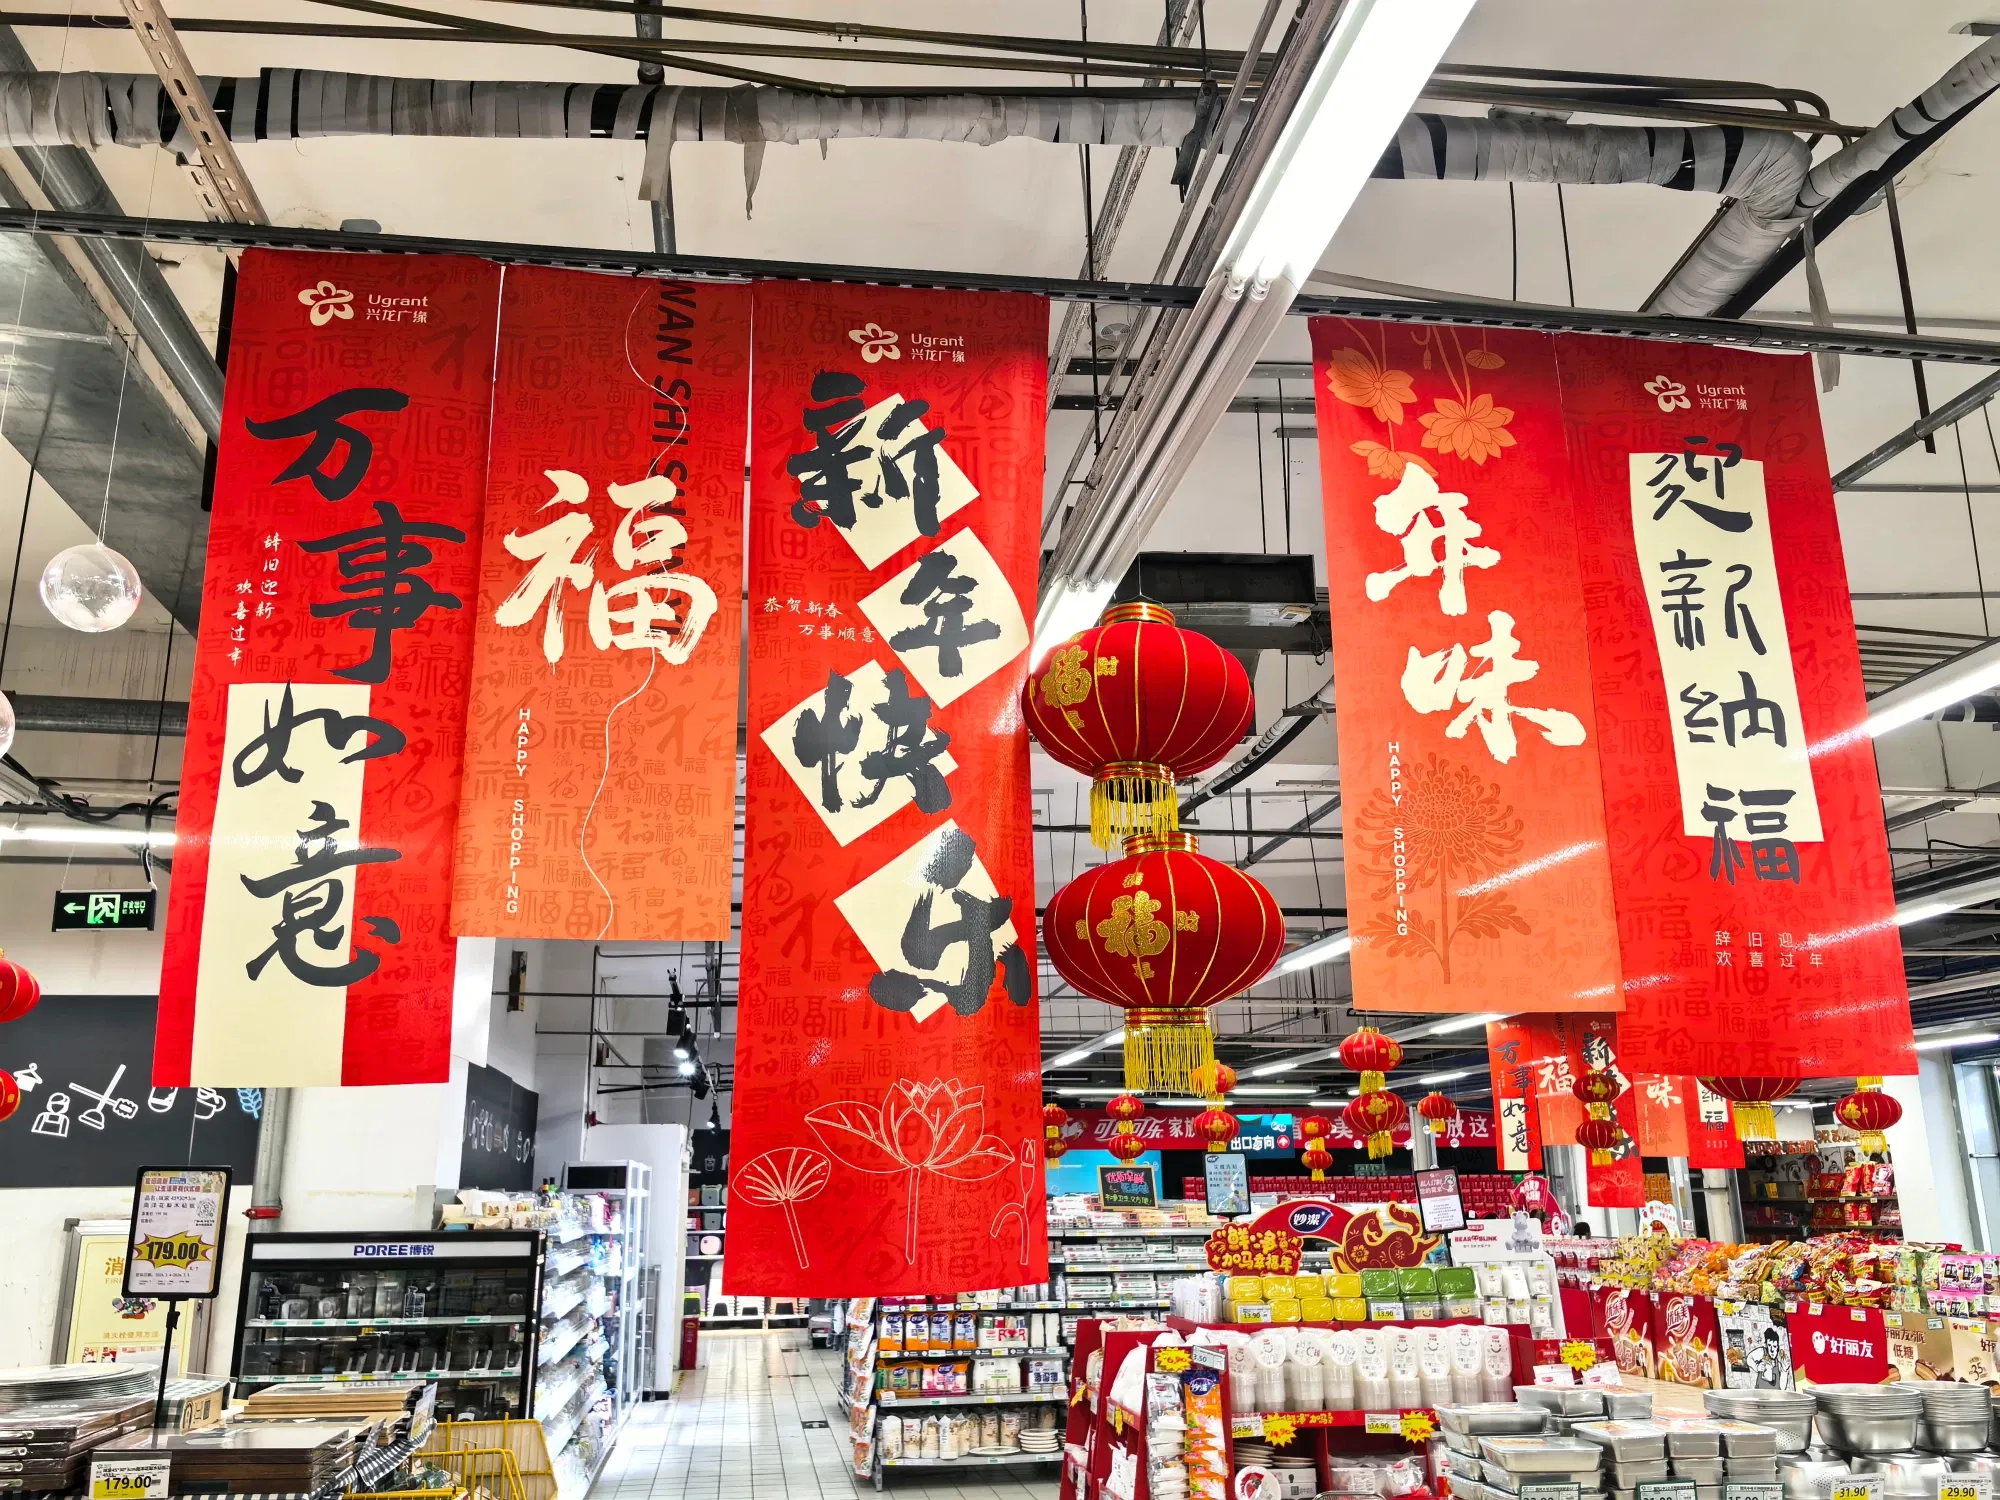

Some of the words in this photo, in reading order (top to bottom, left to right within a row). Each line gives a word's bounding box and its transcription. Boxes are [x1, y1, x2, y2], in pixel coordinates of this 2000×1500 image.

[368, 293, 429, 308] Ugrant
[366, 308, 429, 324] 兴龙广缘
[656, 279, 697, 366] WAN
[911, 333, 965, 347] Ugrant
[910, 348, 966, 363] 兴龙广缘
[1696, 384, 1746, 396] Ugrant
[651, 375, 692, 447] SHI
[1699, 397, 1749, 411] 兴龙广缘
[255, 532, 283, 620] 辞旧迎新
[494, 468, 719, 675] 福
[763, 596, 844, 619] 恭贺新春
[1365, 461, 1586, 765] 年味
[226, 581, 253, 667] 欢喜过年
[798, 623, 877, 644] 万事顺意
[1646, 435, 1800, 886] 迎新纳福
[232, 387, 466, 987] 万事如意
[517, 707, 531, 778] HAPPY
[1387, 741, 1402, 808] HAPPY
[506, 798, 526, 914] SHOPPING
[1392, 827, 1408, 936] SHOPPING
[1716, 951, 1824, 969] 欢喜过年
[1538, 1055, 1577, 1097] 福
[1494, 1041, 1534, 1154] 万事如意
[1231, 1135, 1275, 1151] 出口方向
[146, 1241, 199, 1260] 179.00
[1830, 1336, 1874, 1358] 好丽友
[1893, 1343, 1914, 1359] 低糖
[105, 1475, 152, 1490] 179.00
[1839, 1487, 1867, 1498] 31.90
[1947, 1487, 1976, 1497] 29.90
